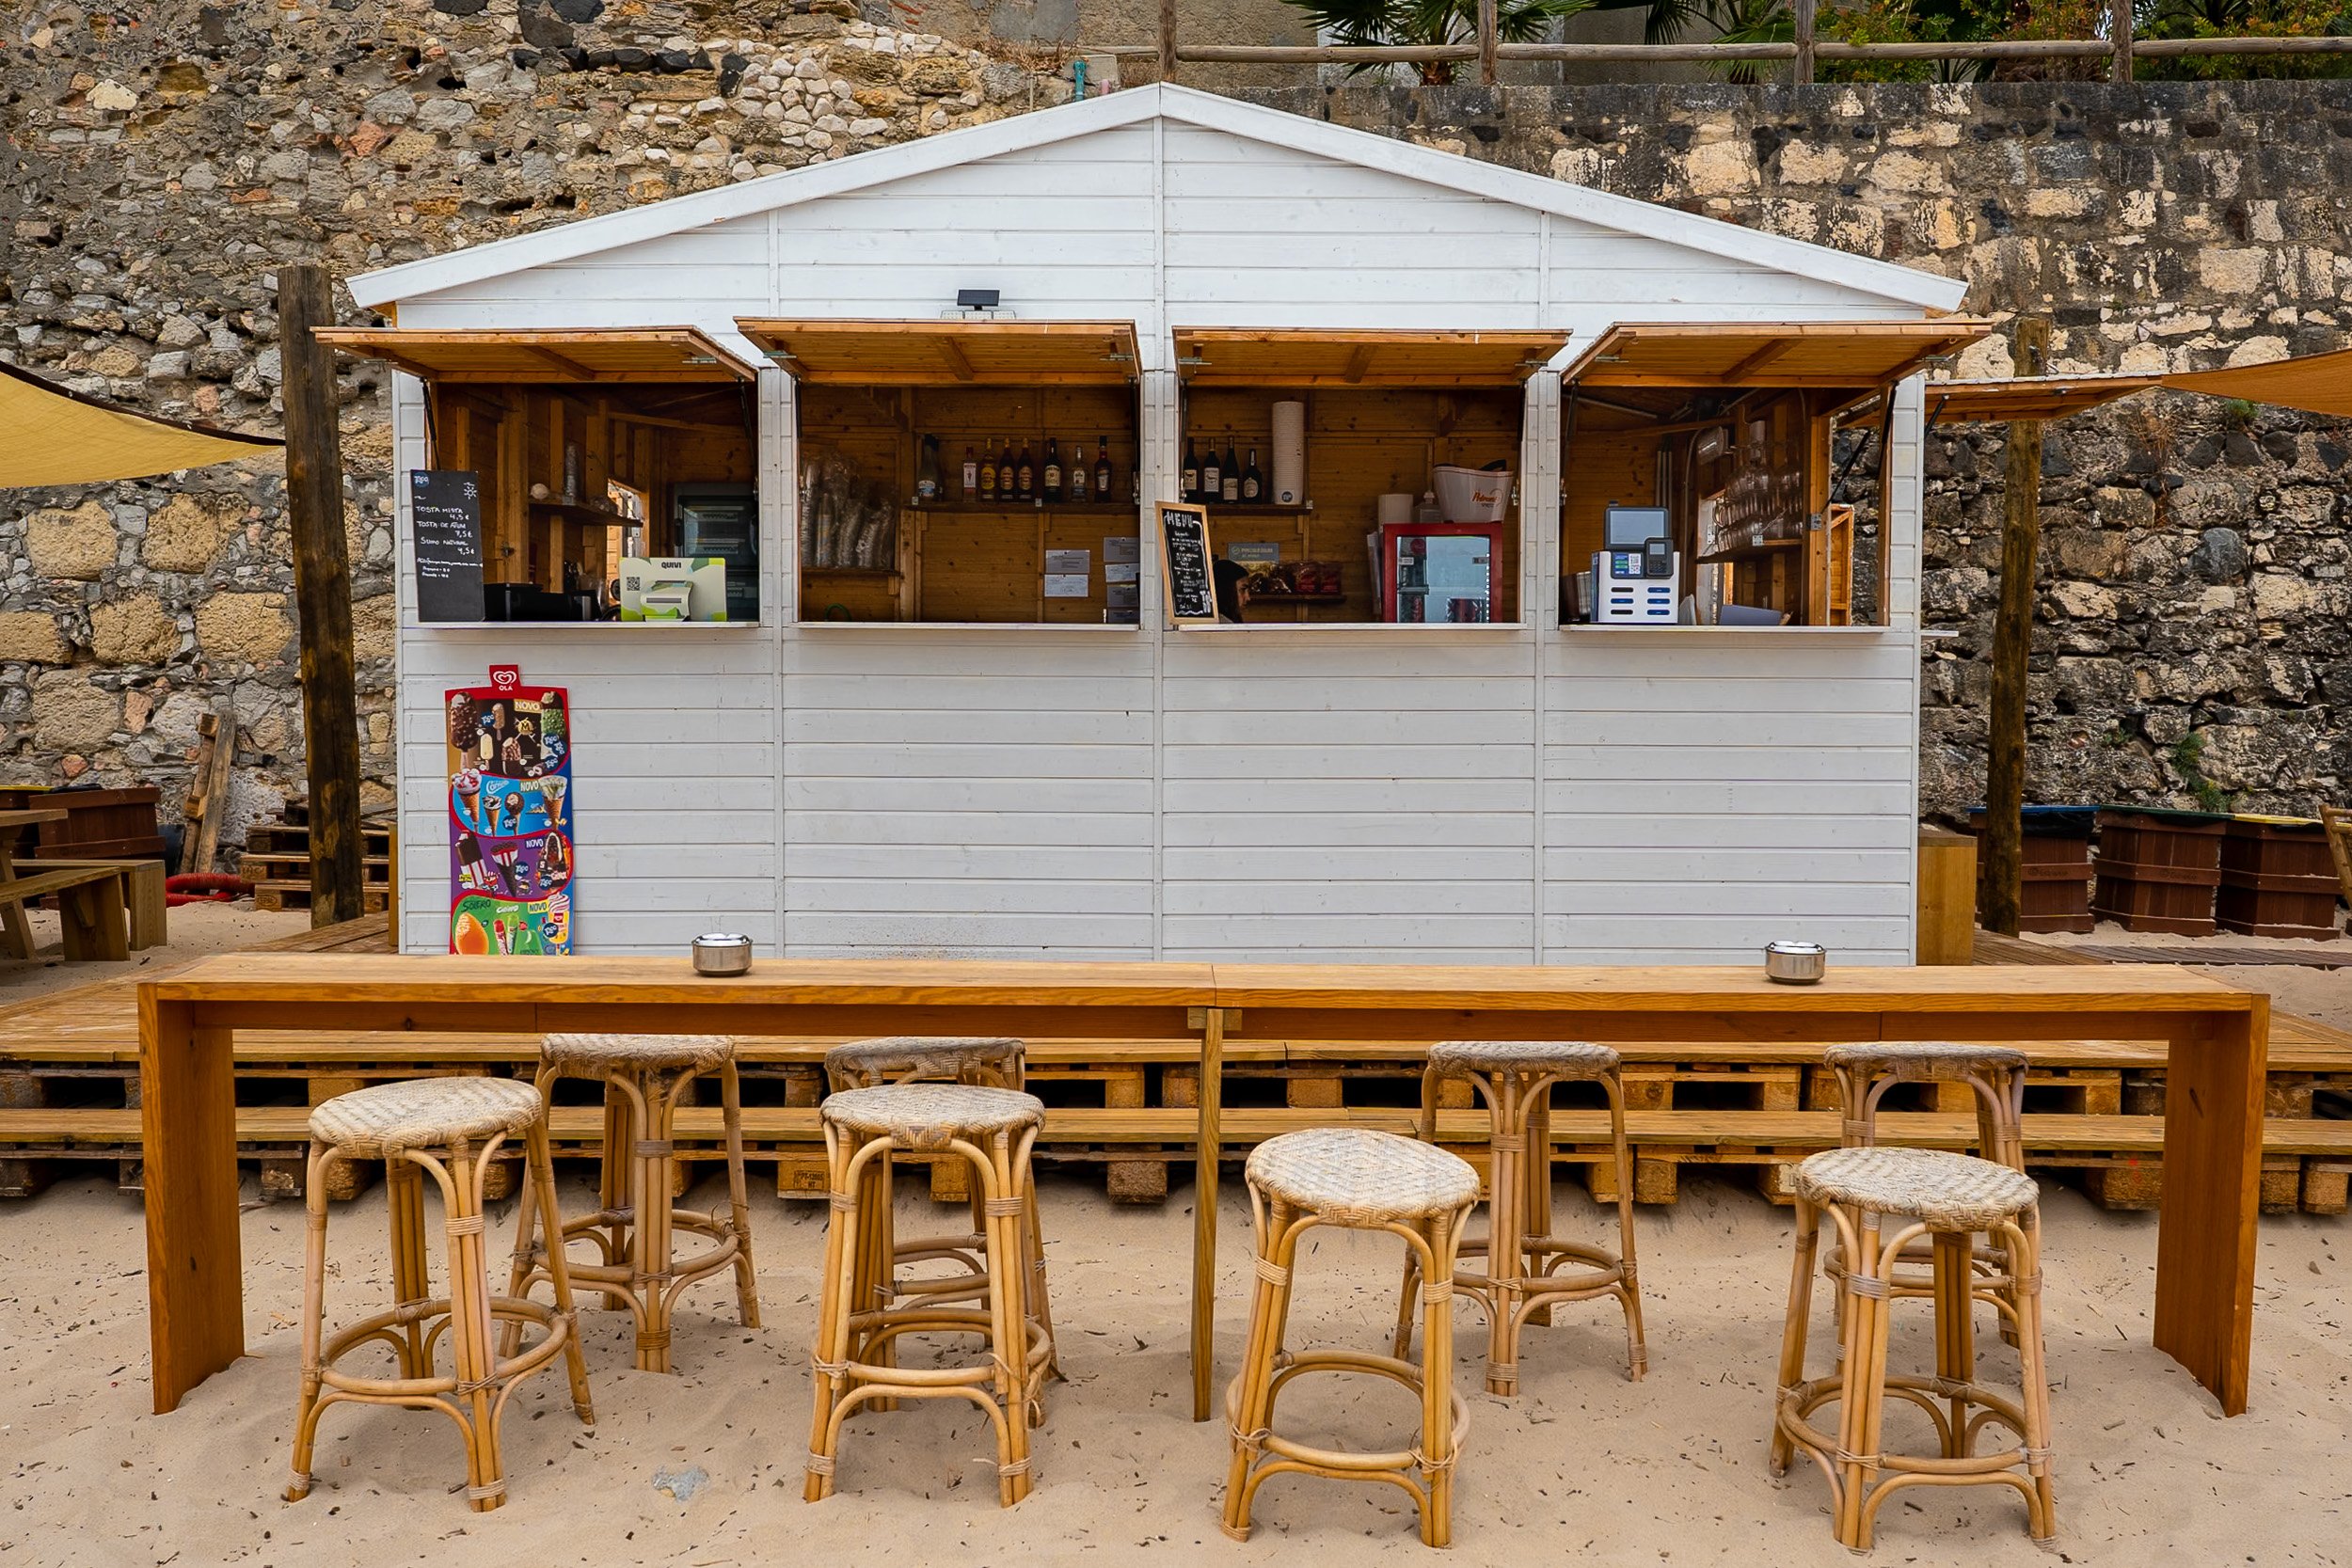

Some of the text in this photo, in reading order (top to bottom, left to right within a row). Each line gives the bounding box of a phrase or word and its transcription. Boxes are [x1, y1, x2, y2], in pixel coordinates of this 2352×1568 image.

[416, 505, 440, 514] TOSTA
[1167, 511, 1193, 528] MENU
[417, 520, 437, 529] TOSTA
[515, 701, 540, 710] NOVO
[520, 781, 539, 791] NOVO
[526, 838, 544, 847] NOVO
[529, 903, 547, 911] NOVO
